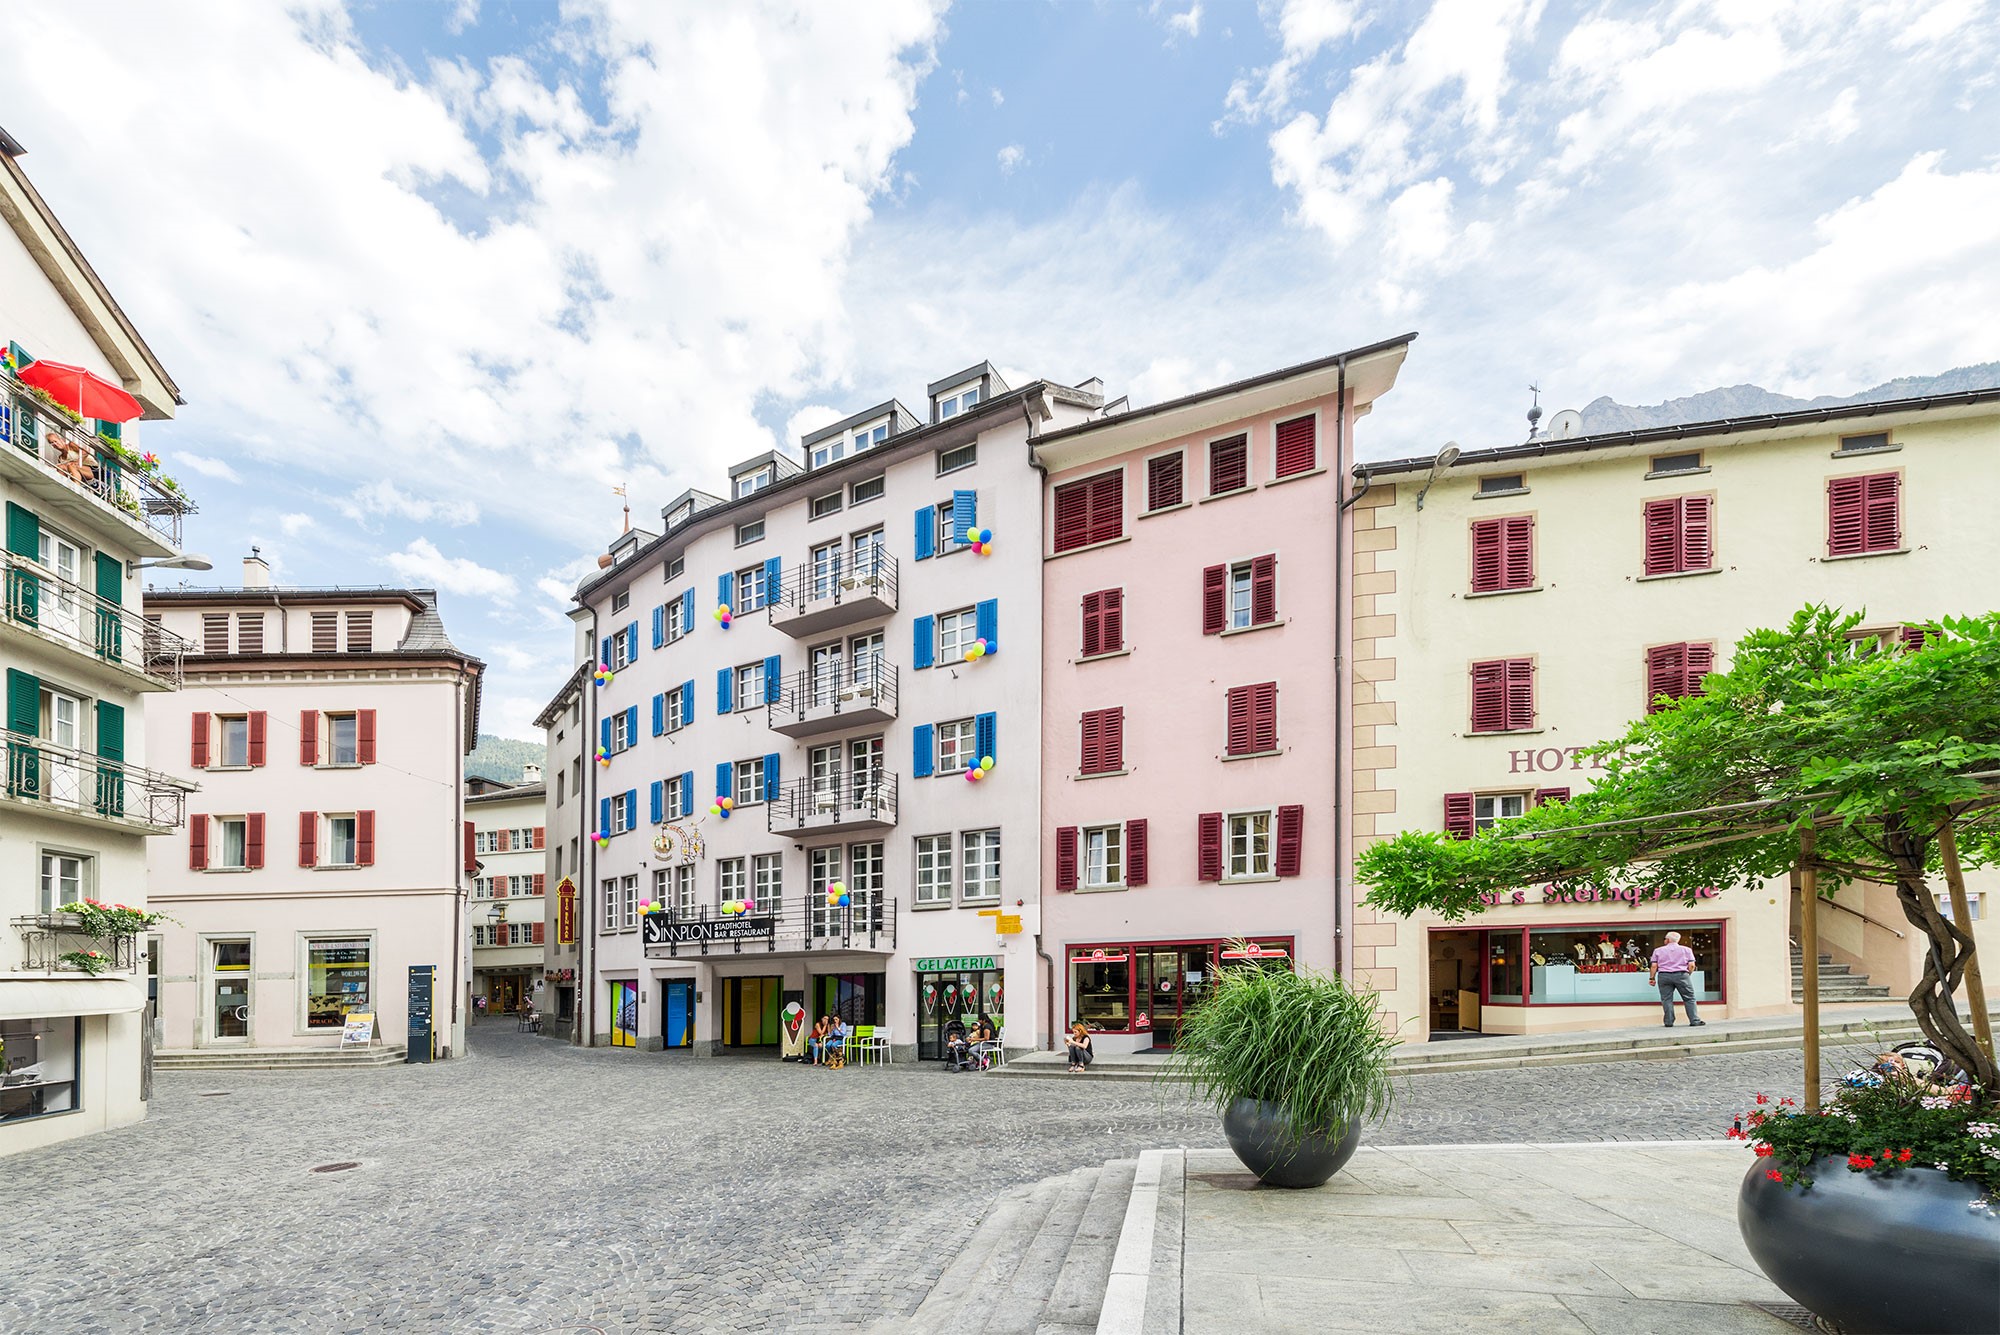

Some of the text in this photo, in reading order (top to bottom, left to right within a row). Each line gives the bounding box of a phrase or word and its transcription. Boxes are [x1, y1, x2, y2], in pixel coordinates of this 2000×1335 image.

[1543, 883, 1719, 908] Steinque
[714, 921, 753, 930] STADTHOTEL
[714, 927, 770, 939] BAR RESTAURANT
[917, 956, 995, 971] GELATERIA
[1579, 964, 1637, 974] TRADITION
